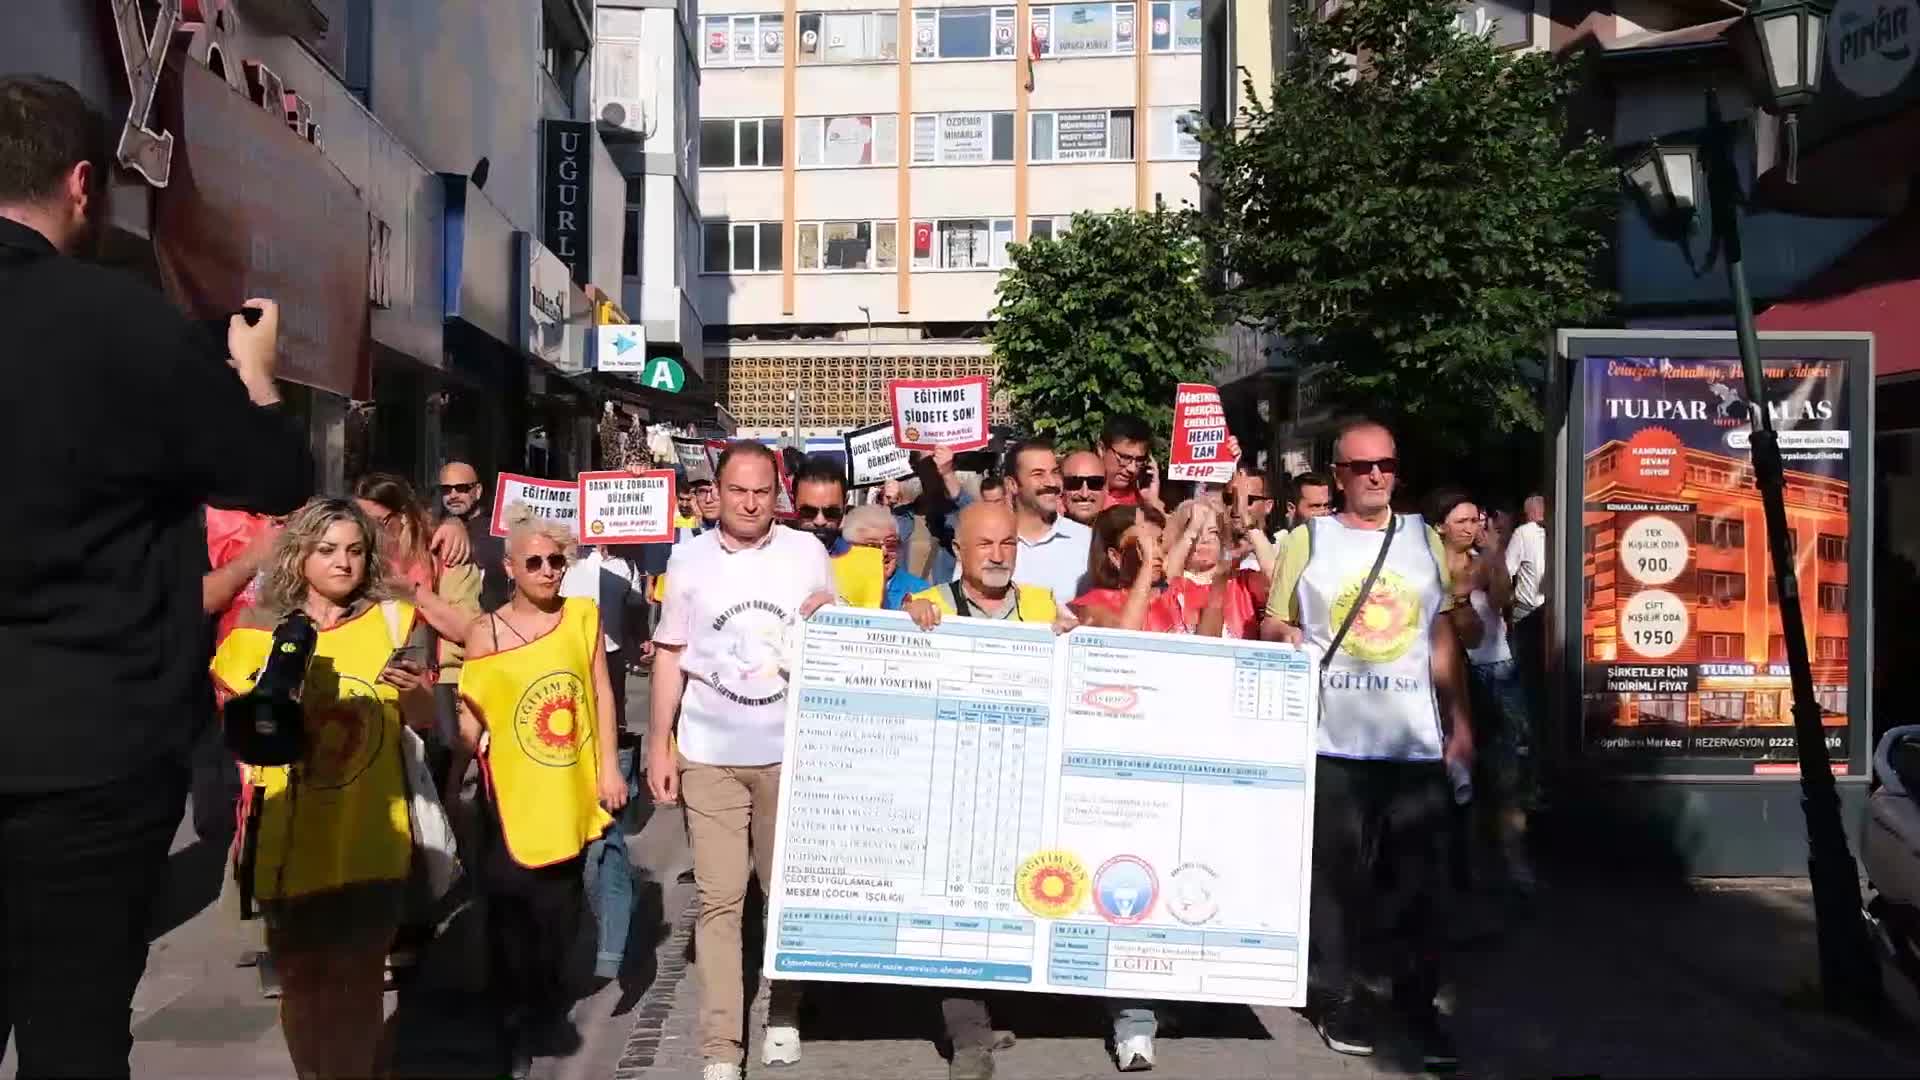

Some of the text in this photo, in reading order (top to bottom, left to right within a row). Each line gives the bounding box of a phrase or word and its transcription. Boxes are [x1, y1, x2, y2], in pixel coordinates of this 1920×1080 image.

[651, 361, 674, 388] A
[913, 387, 966, 404] EĞİTİMDE
[904, 406, 976, 425] ŞİDDETE SON!
[1606, 398, 1708, 421] TULPAR
[1189, 429, 1223, 443] HEMEN
[1194, 446, 1215, 458] ZAM
[1186, 465, 1214, 477] EHP
[614, 480, 624, 490] VE
[522, 486, 572, 503] EĞİTİMDE
[1645, 528, 1663, 537] TEK
[1662, 613, 1681, 622] ODA
[1607, 665, 1688, 679] ŞİRKETLER İÇİN
[1607, 679, 1688, 692] İNDİRİMLİ FİYAT
[1695, 737, 1765, 748] REZERVASYON
[1768, 737, 1794, 747] 0222
[785, 888, 820, 897] MESEM
